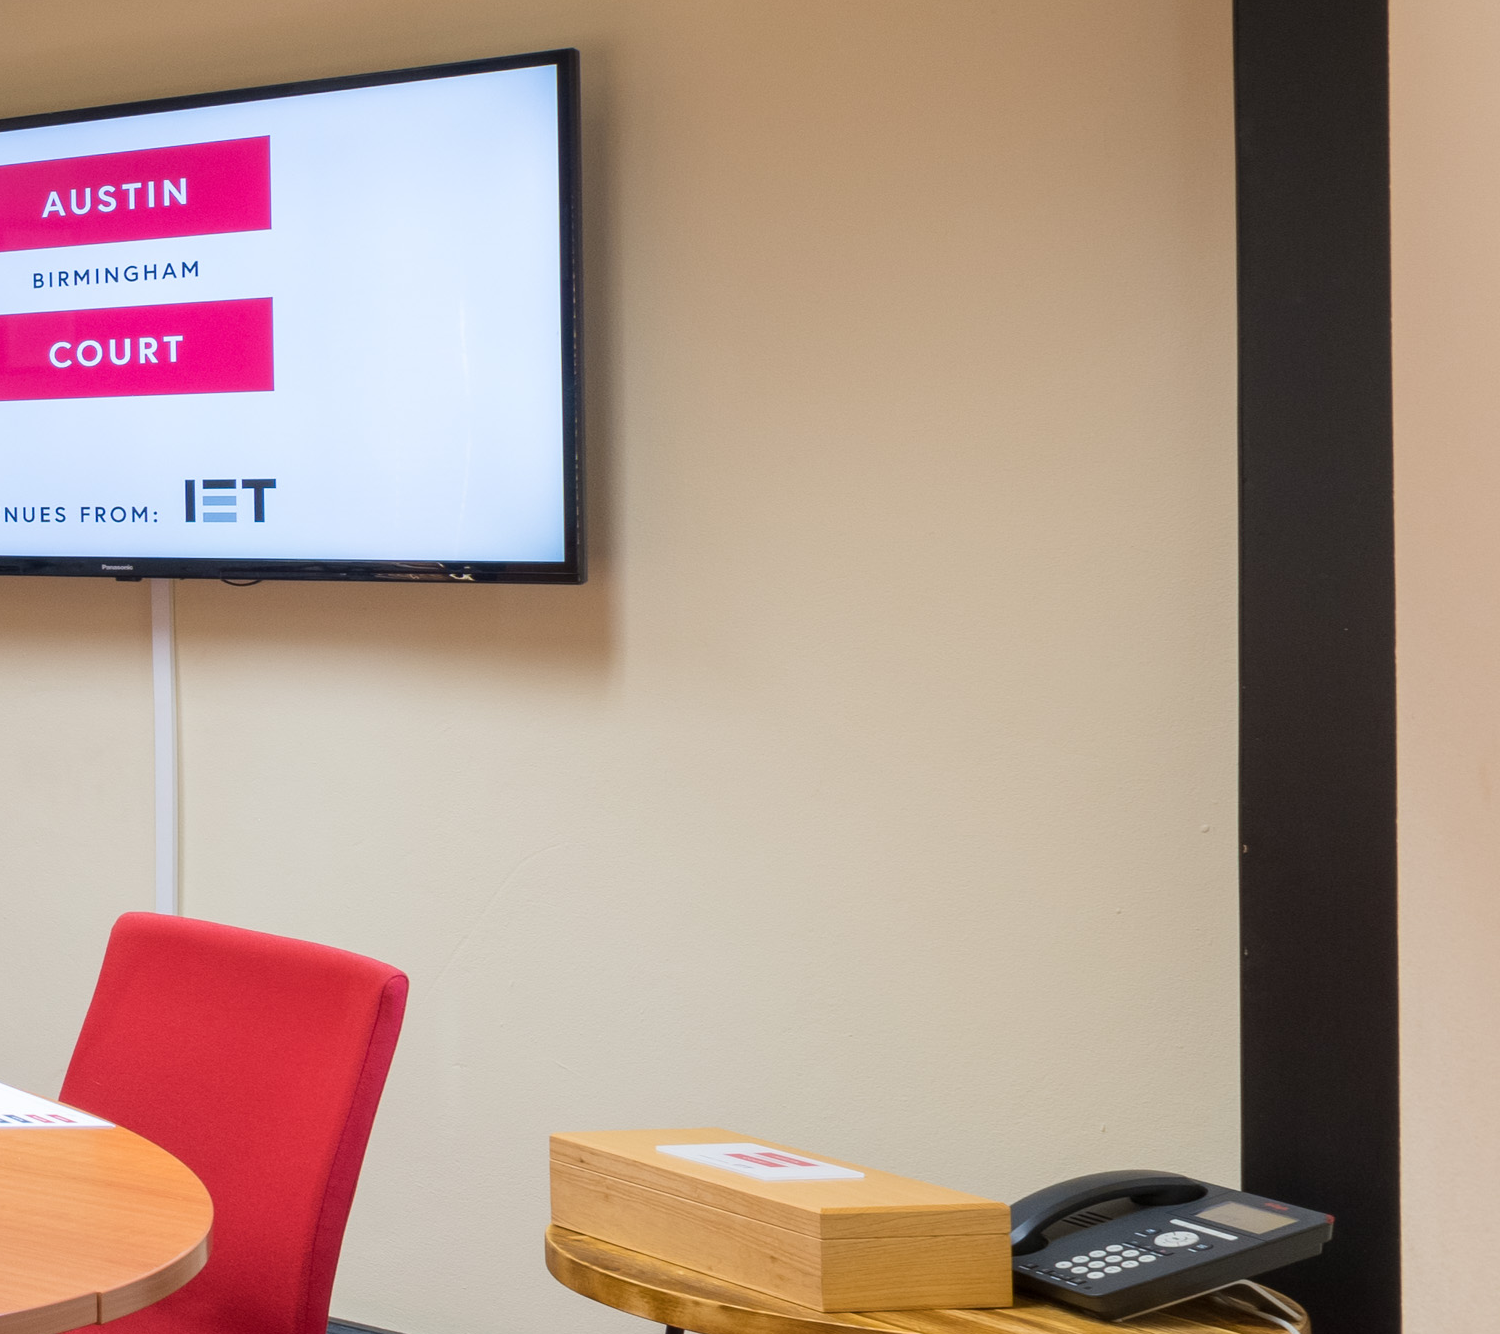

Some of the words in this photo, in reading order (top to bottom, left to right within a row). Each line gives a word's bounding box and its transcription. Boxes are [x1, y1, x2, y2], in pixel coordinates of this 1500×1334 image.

[41, 177, 188, 218] AUSTIN
[32, 260, 200, 289] BIRMINGHAM
[49, 335, 184, 369] COURT
[80, 506, 159, 523] FROM:
[184, 478, 277, 523] IET
